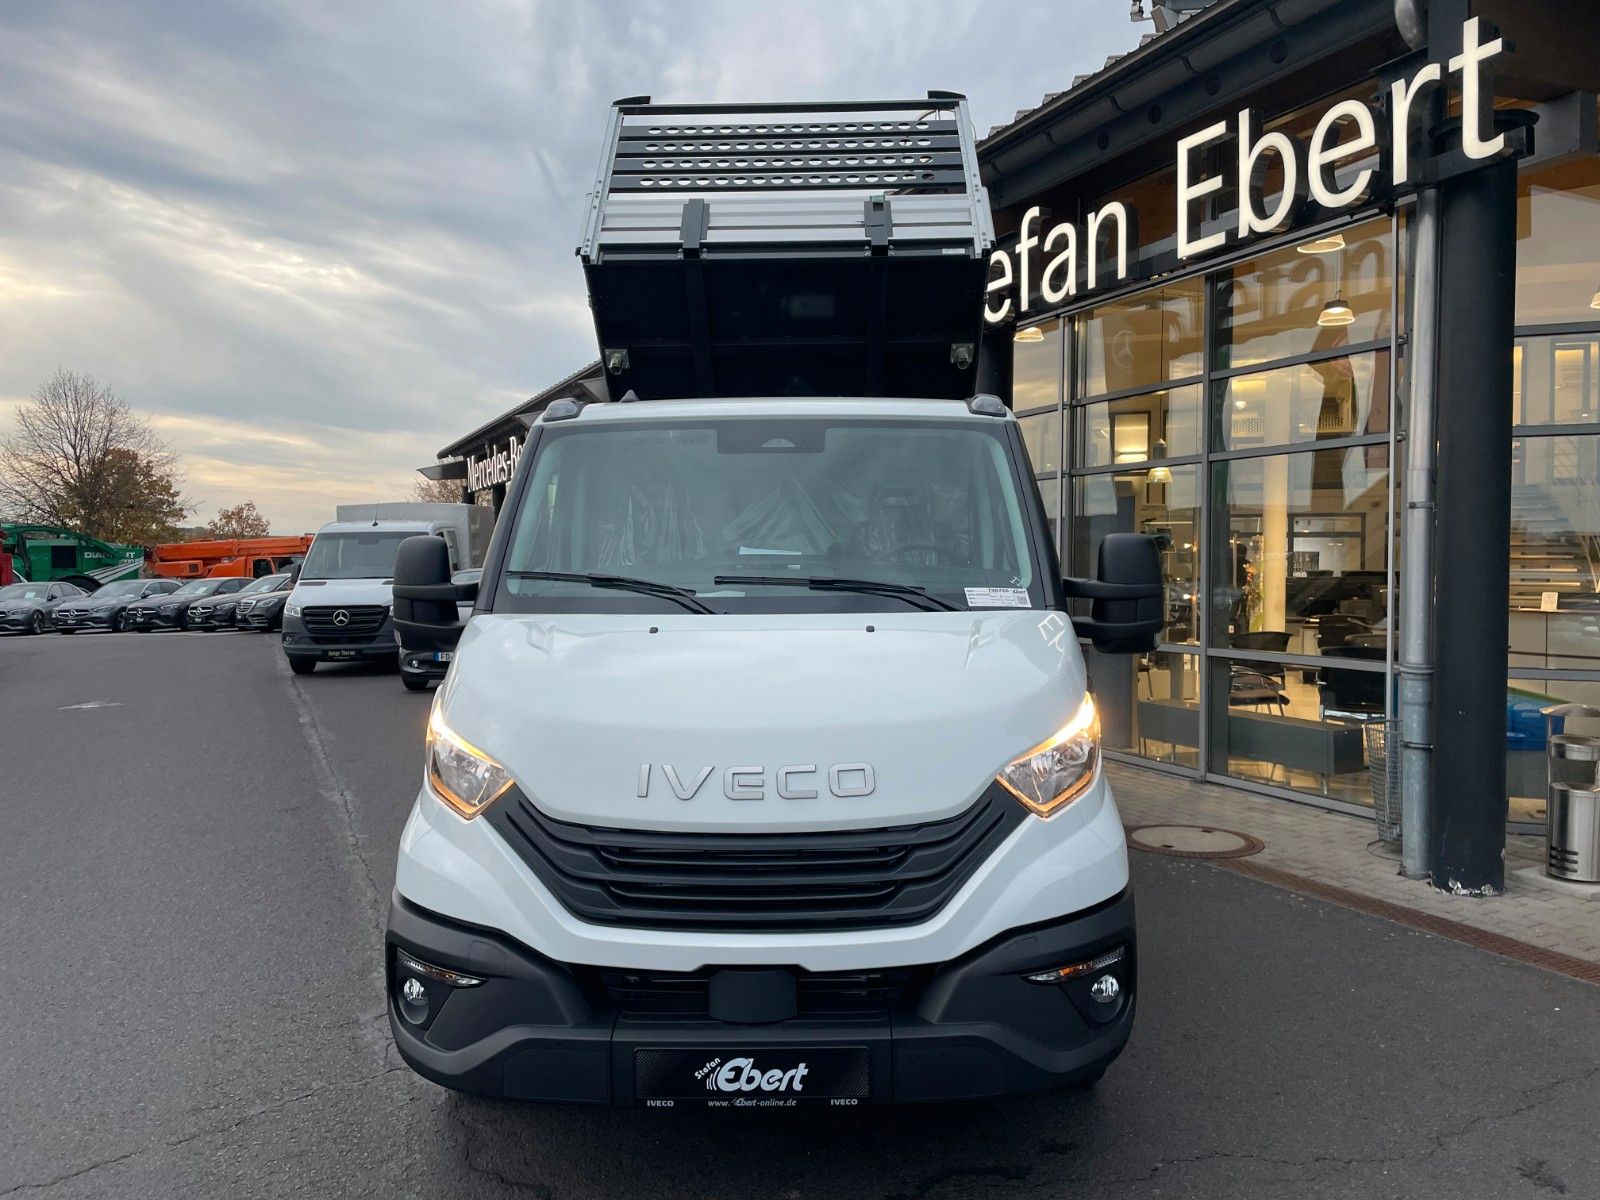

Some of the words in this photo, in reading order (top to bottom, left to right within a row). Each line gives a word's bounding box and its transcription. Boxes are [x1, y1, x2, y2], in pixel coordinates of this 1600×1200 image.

[1177, 16, 1504, 260] Ebert
[637, 762, 876, 800] IVECO
[694, 1057, 721, 1079] Stefan
[716, 1057, 809, 1092] Ebert
